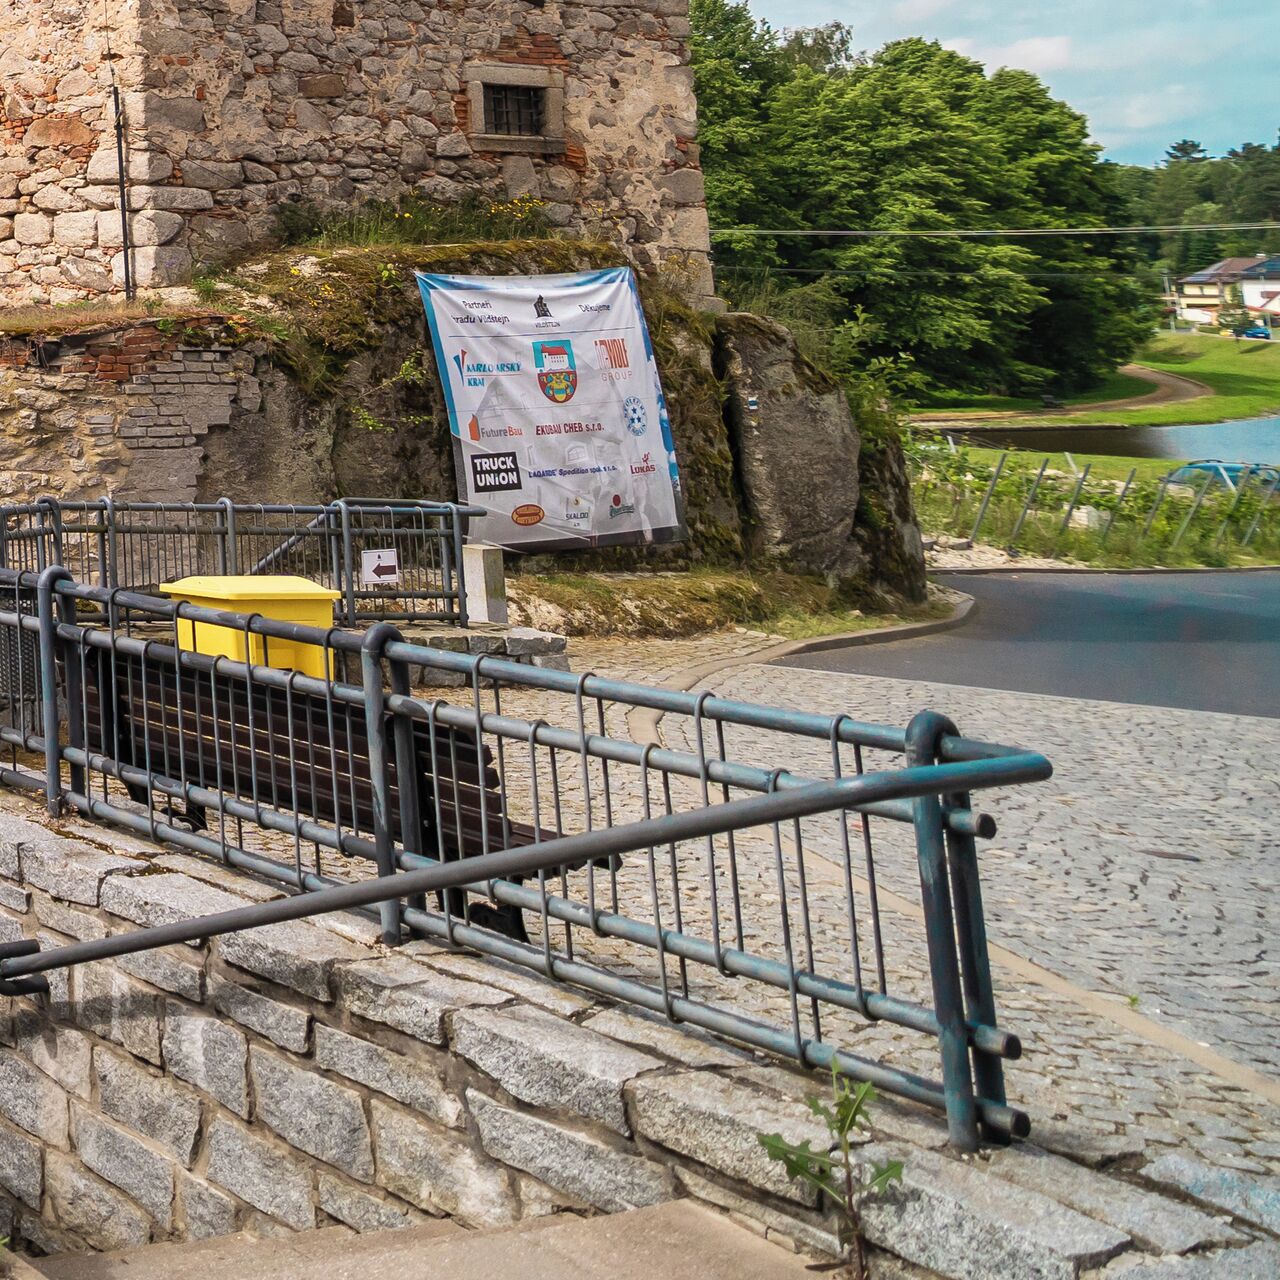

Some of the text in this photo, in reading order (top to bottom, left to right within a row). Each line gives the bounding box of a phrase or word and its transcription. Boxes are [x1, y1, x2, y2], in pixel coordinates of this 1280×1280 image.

[601, 370, 633, 382] GROUP
[480, 425, 523, 438] FutureBau
[563, 422, 583, 434] CHEB
[585, 422, 605, 432] s.r.o.
[474, 456, 515, 471] TRUCK
